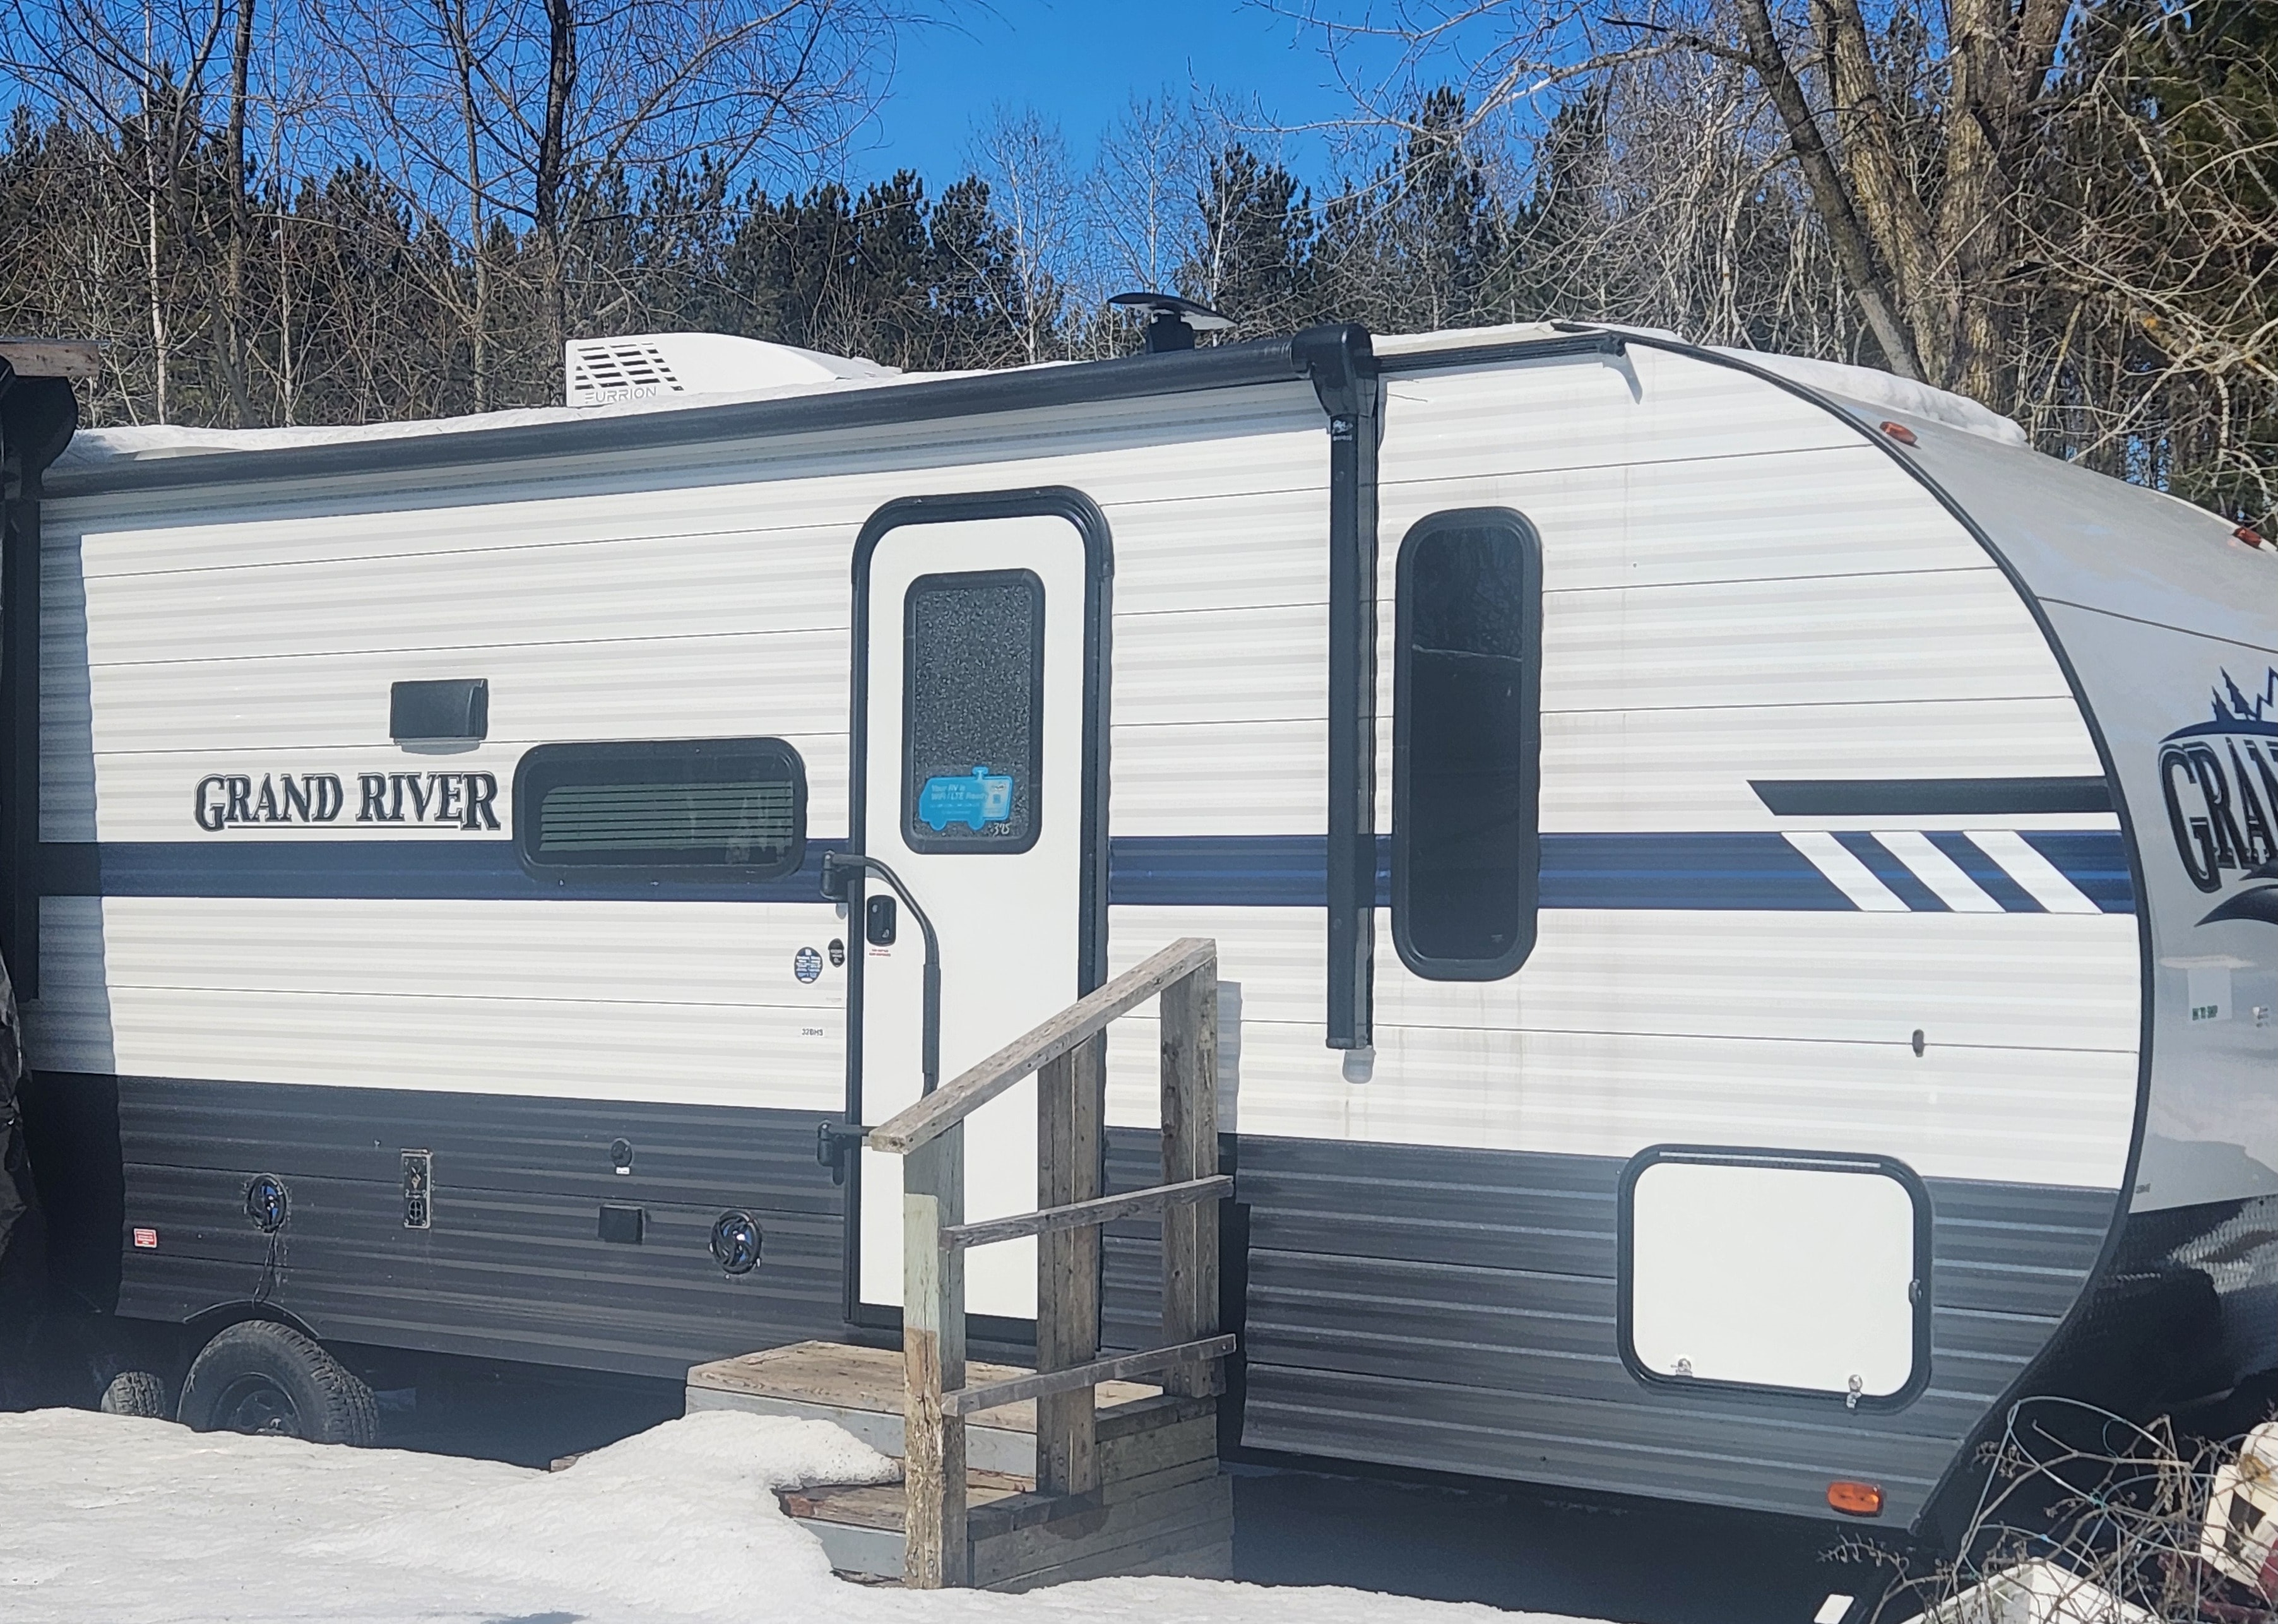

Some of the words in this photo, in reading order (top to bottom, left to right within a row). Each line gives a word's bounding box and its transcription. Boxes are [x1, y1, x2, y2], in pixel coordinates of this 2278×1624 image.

[584, 386, 656, 404] FURRION
[193, 773, 343, 832] GRAND
[356, 770, 502, 831] RIVER
